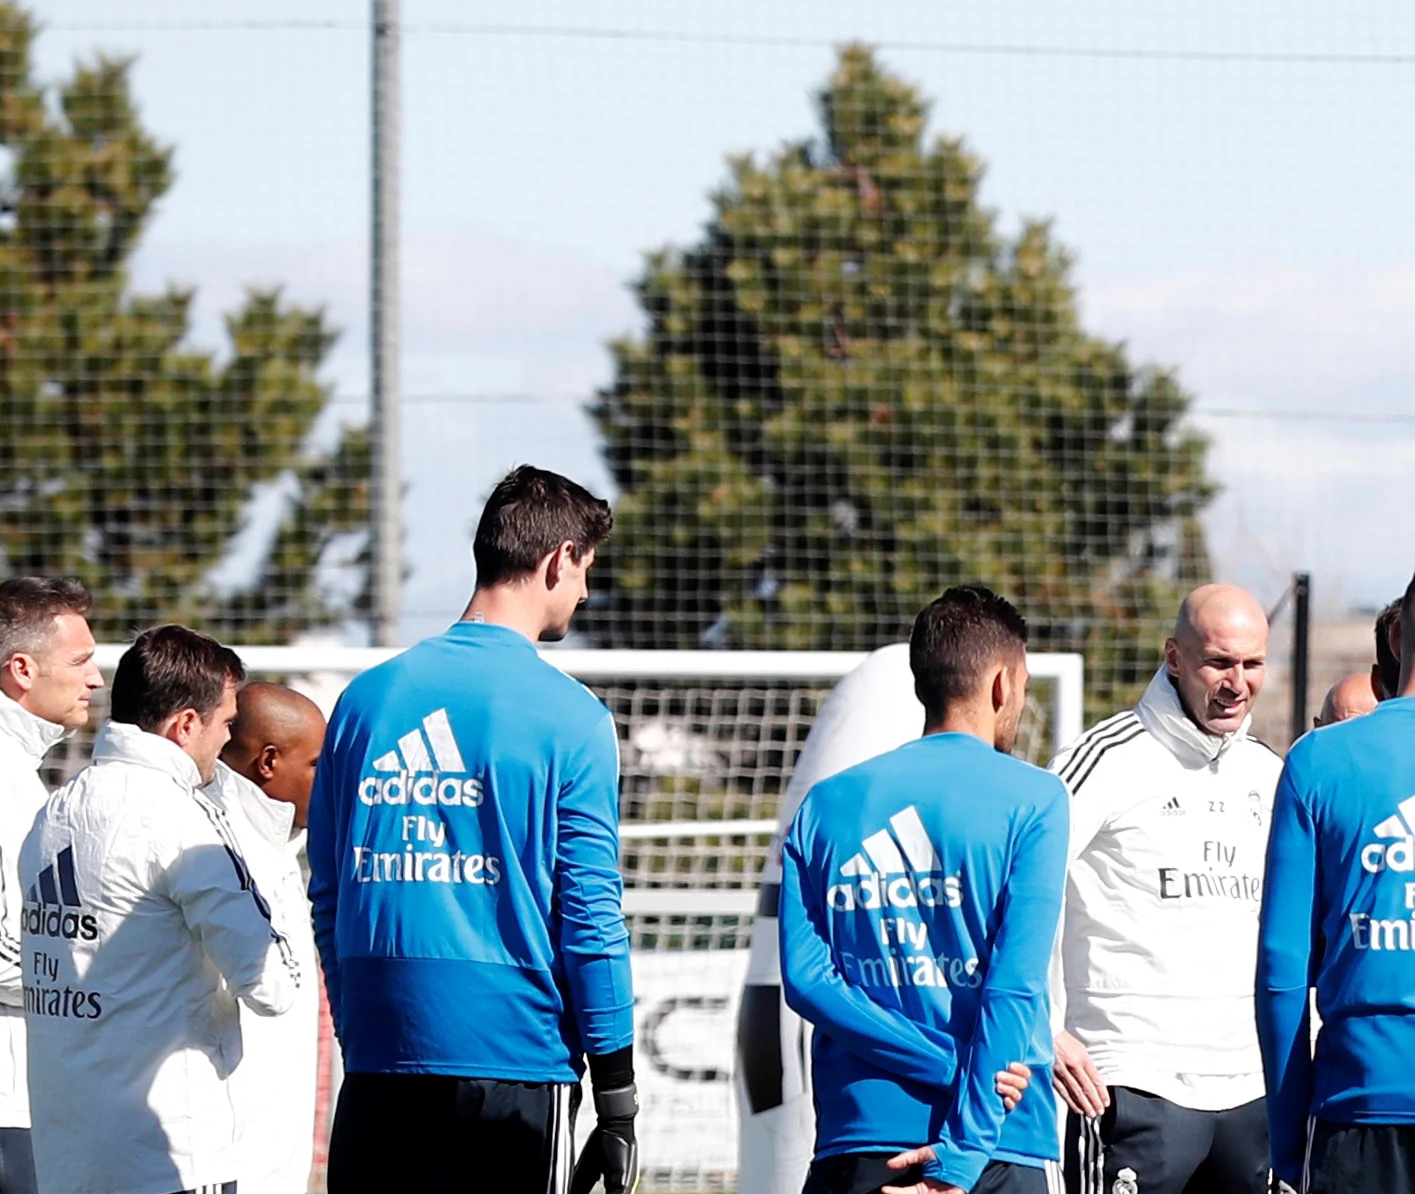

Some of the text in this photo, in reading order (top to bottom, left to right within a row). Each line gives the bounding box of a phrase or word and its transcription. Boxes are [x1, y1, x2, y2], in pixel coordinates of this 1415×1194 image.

[358, 770, 484, 807] adidas
[402, 815, 447, 847] Fly
[353, 844, 501, 885] Emirates
[1203, 841, 1236, 867] Fly
[827, 871, 963, 912] adidas
[1158, 867, 1261, 902] Emirate
[880, 918, 928, 950] Fly
[34, 951, 59, 981] Fly
[841, 950, 982, 988] Emirates
[24, 980, 102, 1019] mirates
